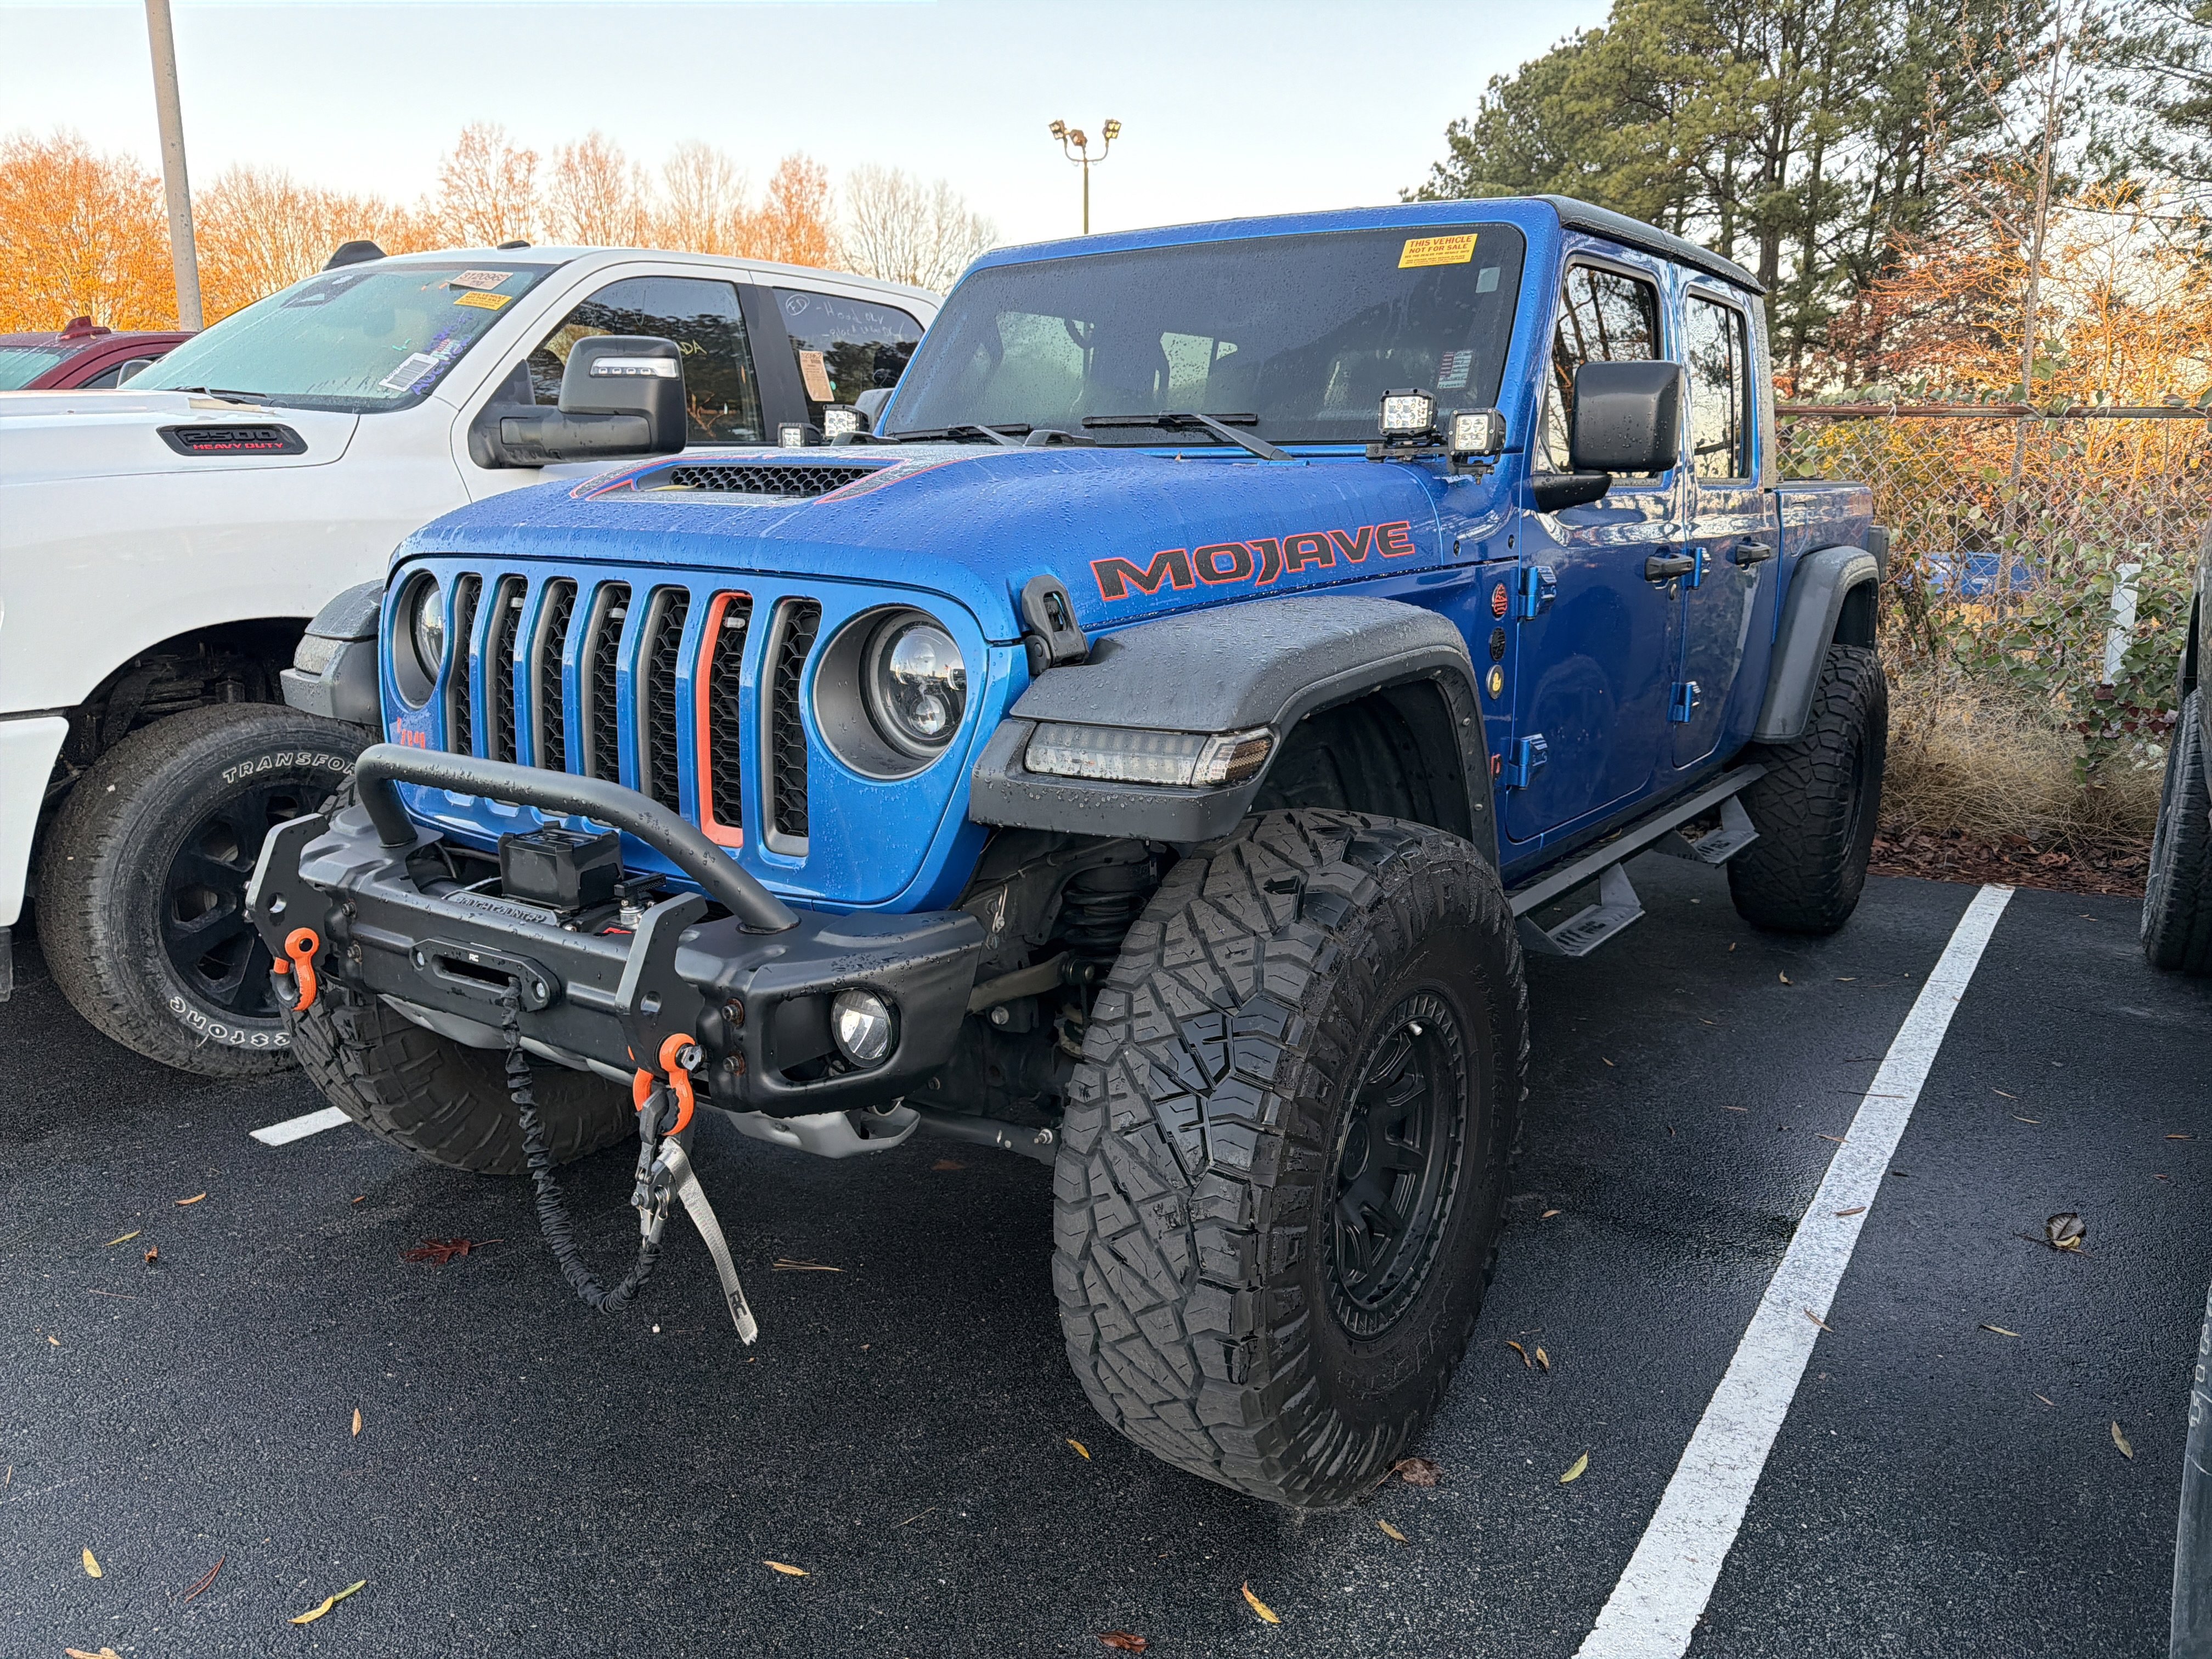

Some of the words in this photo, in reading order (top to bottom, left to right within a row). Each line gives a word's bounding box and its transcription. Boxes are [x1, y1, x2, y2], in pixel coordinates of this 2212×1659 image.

[1410, 239, 1430, 247] THIS
[1434, 236, 1472, 245] VEHICLE
[182, 430, 278, 443] 2500
[1089, 521, 1415, 601] MOJAVE
[493, 906, 548, 923] COUNTRY
[469, 953, 479, 962] RC
[729, 1289, 748, 1320] RC
